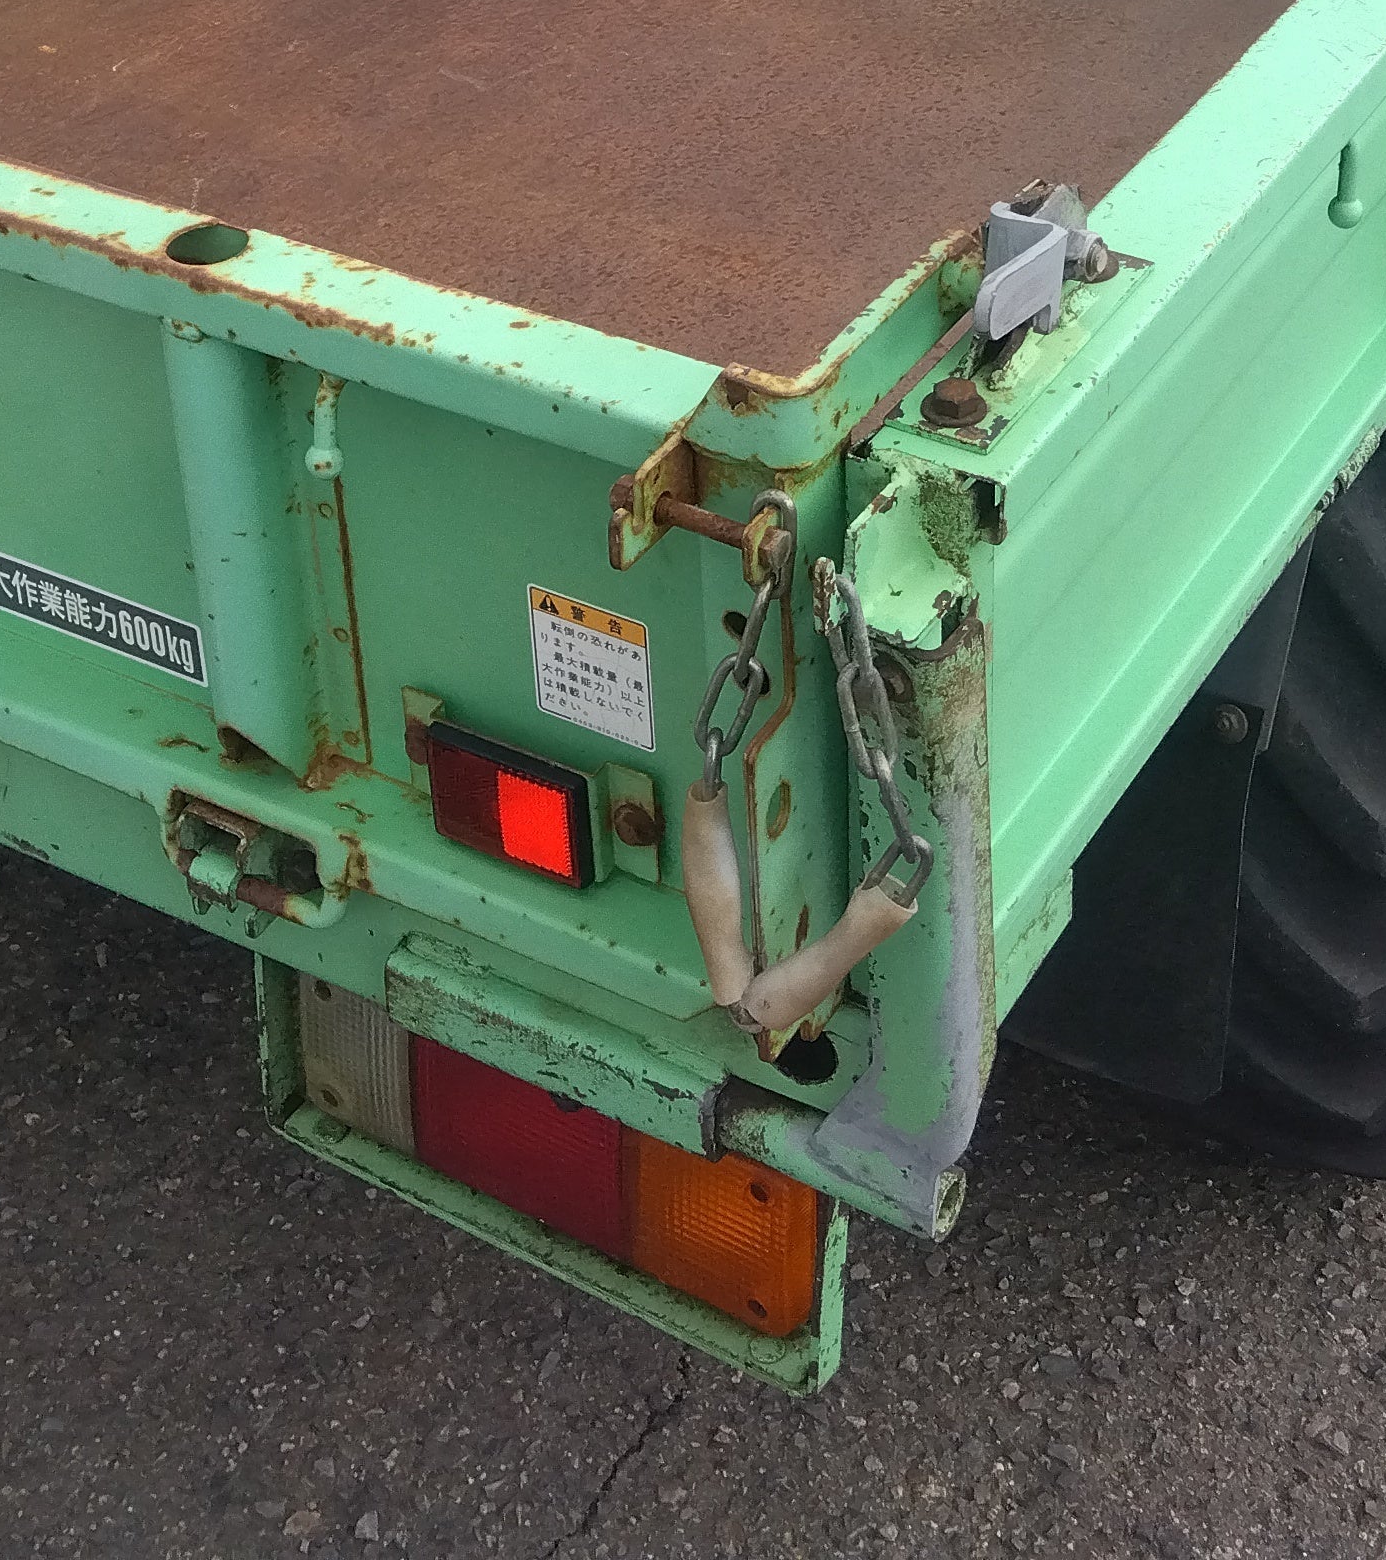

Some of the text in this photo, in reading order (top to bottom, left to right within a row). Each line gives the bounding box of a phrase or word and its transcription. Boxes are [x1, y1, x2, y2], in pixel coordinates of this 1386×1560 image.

[540, 632, 584, 657] ります。
[550, 620, 642, 662] 転倒の恐れがあ
[543, 677, 644, 722] は積載しないでく
[545, 692, 589, 717] ださい。
